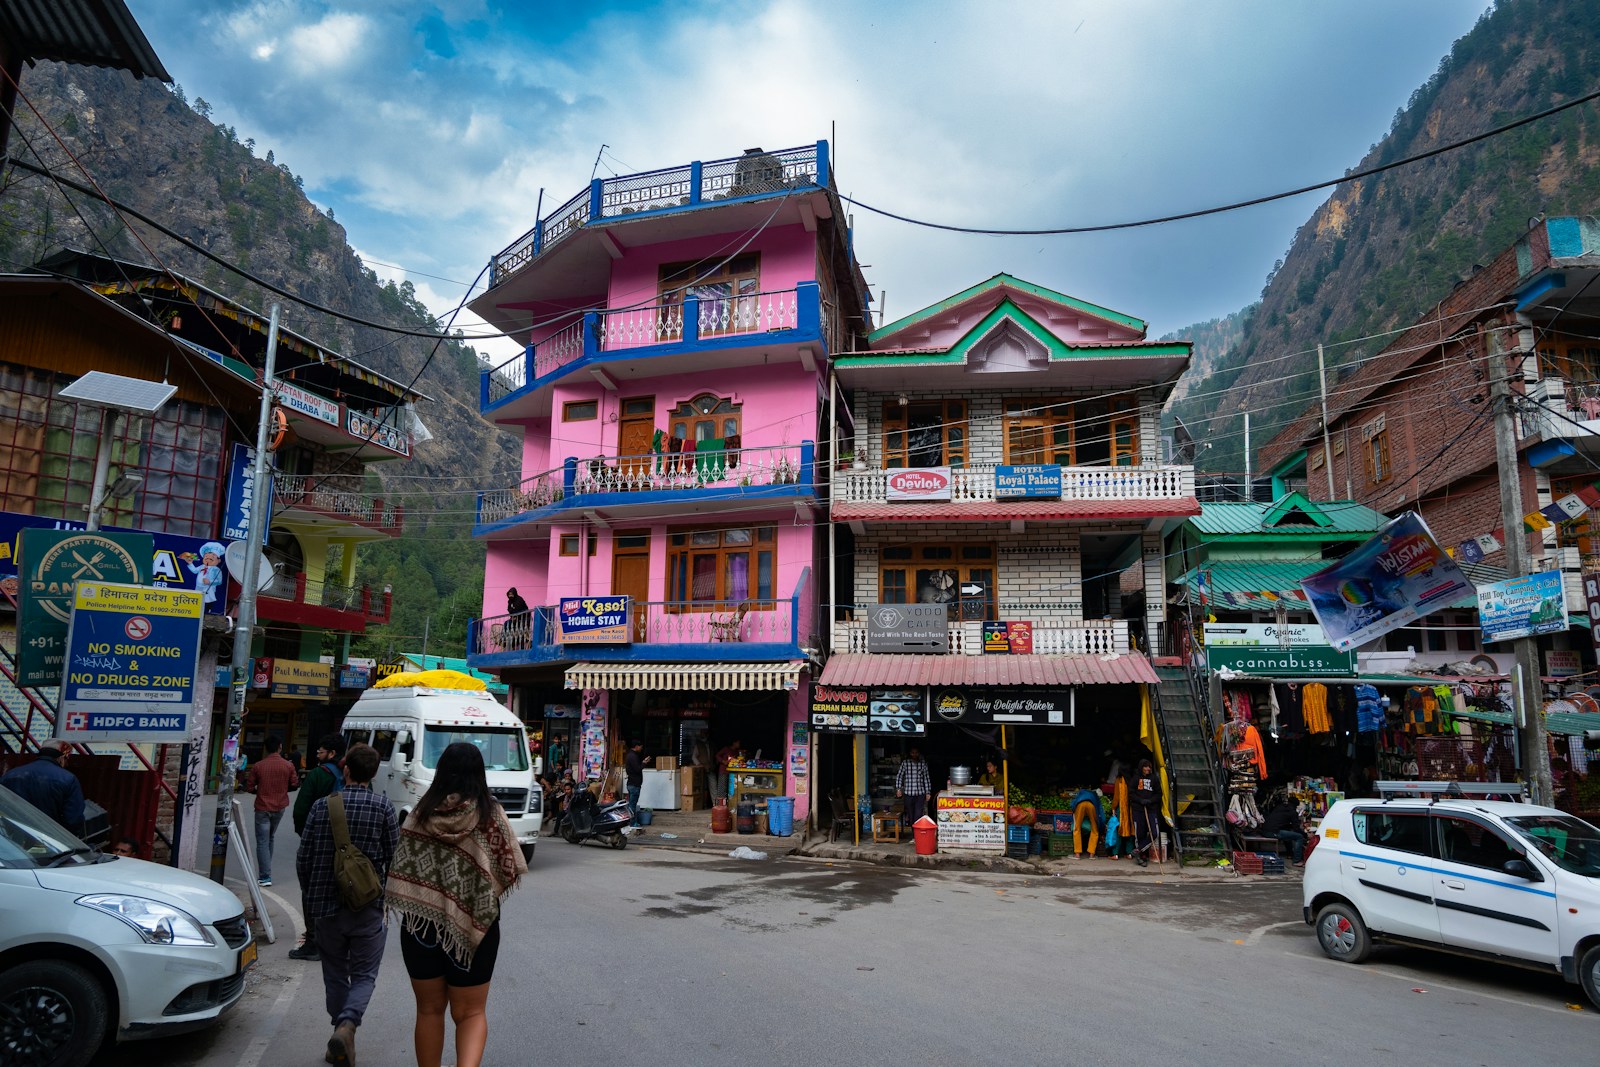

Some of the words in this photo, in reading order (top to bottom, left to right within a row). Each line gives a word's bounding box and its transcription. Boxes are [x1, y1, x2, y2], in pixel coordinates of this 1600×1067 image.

[290, 397, 320, 416] DHABA
[304, 393, 323, 408] ROOF
[323, 401, 338, 414] TOP
[1013, 466, 1044, 474] HOTEL
[896, 477, 942, 489] Devlok
[998, 475, 1026, 487] Royal
[1028, 474, 1059, 485] Palace
[44, 547, 64, 572] WHERE
[63, 540, 91, 550] PARTY
[94, 540, 121, 556] NEVER
[119, 554, 132, 573] ENDS
[97, 562, 121, 570] GRILL
[100, 587, 138, 600] हिमाचल
[143, 592, 167, 603] प्रदेश
[172, 594, 199, 606] पुलिस
[1479, 590, 1492, 601] Hill
[1492, 590, 1504, 600] Top
[1505, 585, 1535, 597] Camping
[107, 603, 135, 611] Helpline
[582, 598, 625, 616] Kasol
[568, 616, 595, 626] HOME
[597, 615, 621, 626] STAY
[907, 620, 942, 628] CAFE
[28, 636, 60, 648] +91-
[984, 632, 1008, 641] DOP
[88, 643, 111, 655] NO
[114, 644, 181, 658] SMOKING
[129, 660, 139, 671] &
[377, 663, 403, 676] PIZZA
[28, 670, 44, 679] mail
[70, 673, 93, 685] NO
[97, 674, 149, 686] DRUGS
[152, 676, 191, 687] ZONE
[814, 685, 868, 703] Bivera
[812, 703, 840, 712] GERMAN
[841, 704, 869, 713] BAKERY
[938, 706, 963, 715] Bakery
[974, 699, 991, 713] Tiny
[993, 699, 1024, 713] Delight
[1025, 700, 1055, 711] Bakers
[93, 716, 135, 727] HDFC
[139, 717, 181, 728] BANK
[938, 798, 971, 808] Mo-Mo
[972, 798, 1005, 808] Corner
